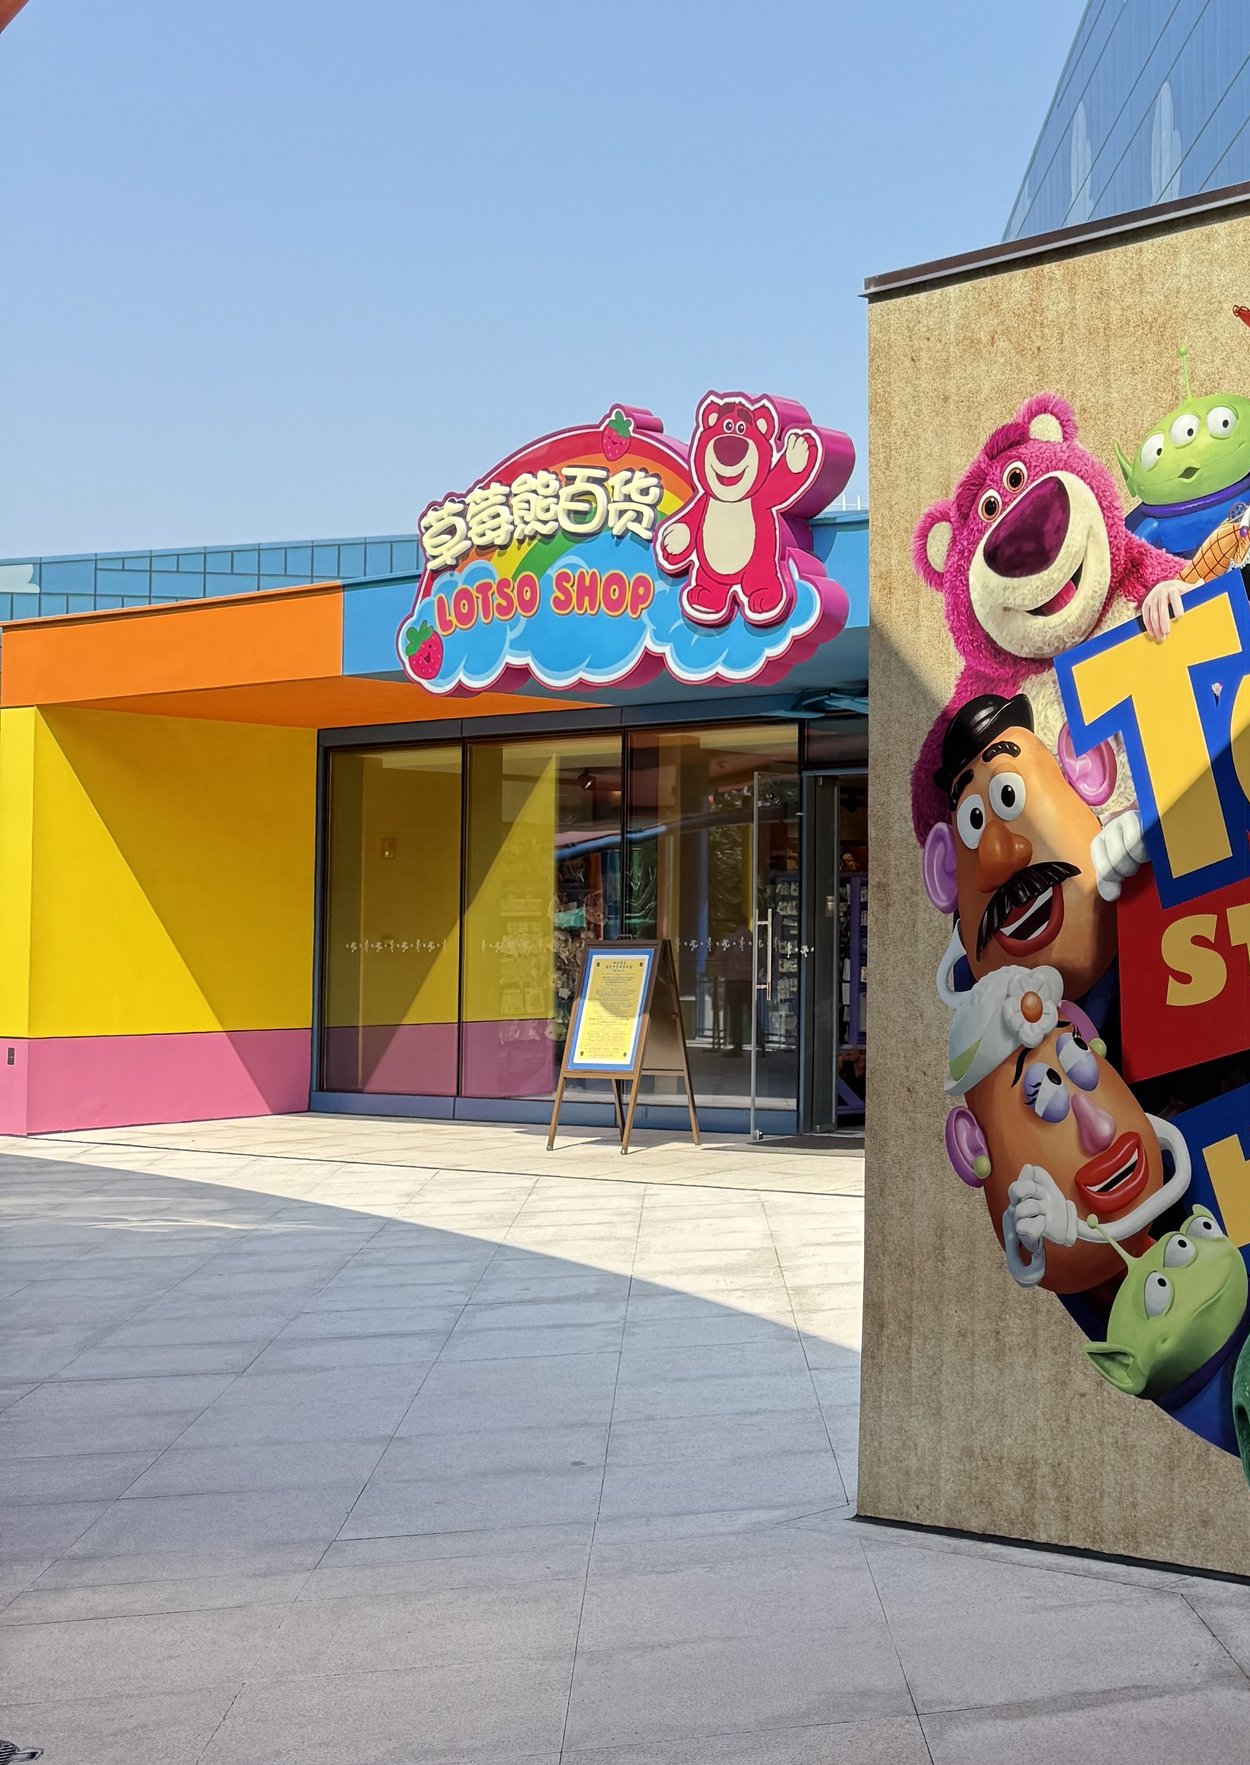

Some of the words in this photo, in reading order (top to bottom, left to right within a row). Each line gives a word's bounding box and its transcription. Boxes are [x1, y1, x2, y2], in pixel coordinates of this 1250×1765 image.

[421, 466, 661, 569] 草莓熊百货
[436, 573, 540, 636] LOTSO
[551, 569, 654, 619] SHOP
